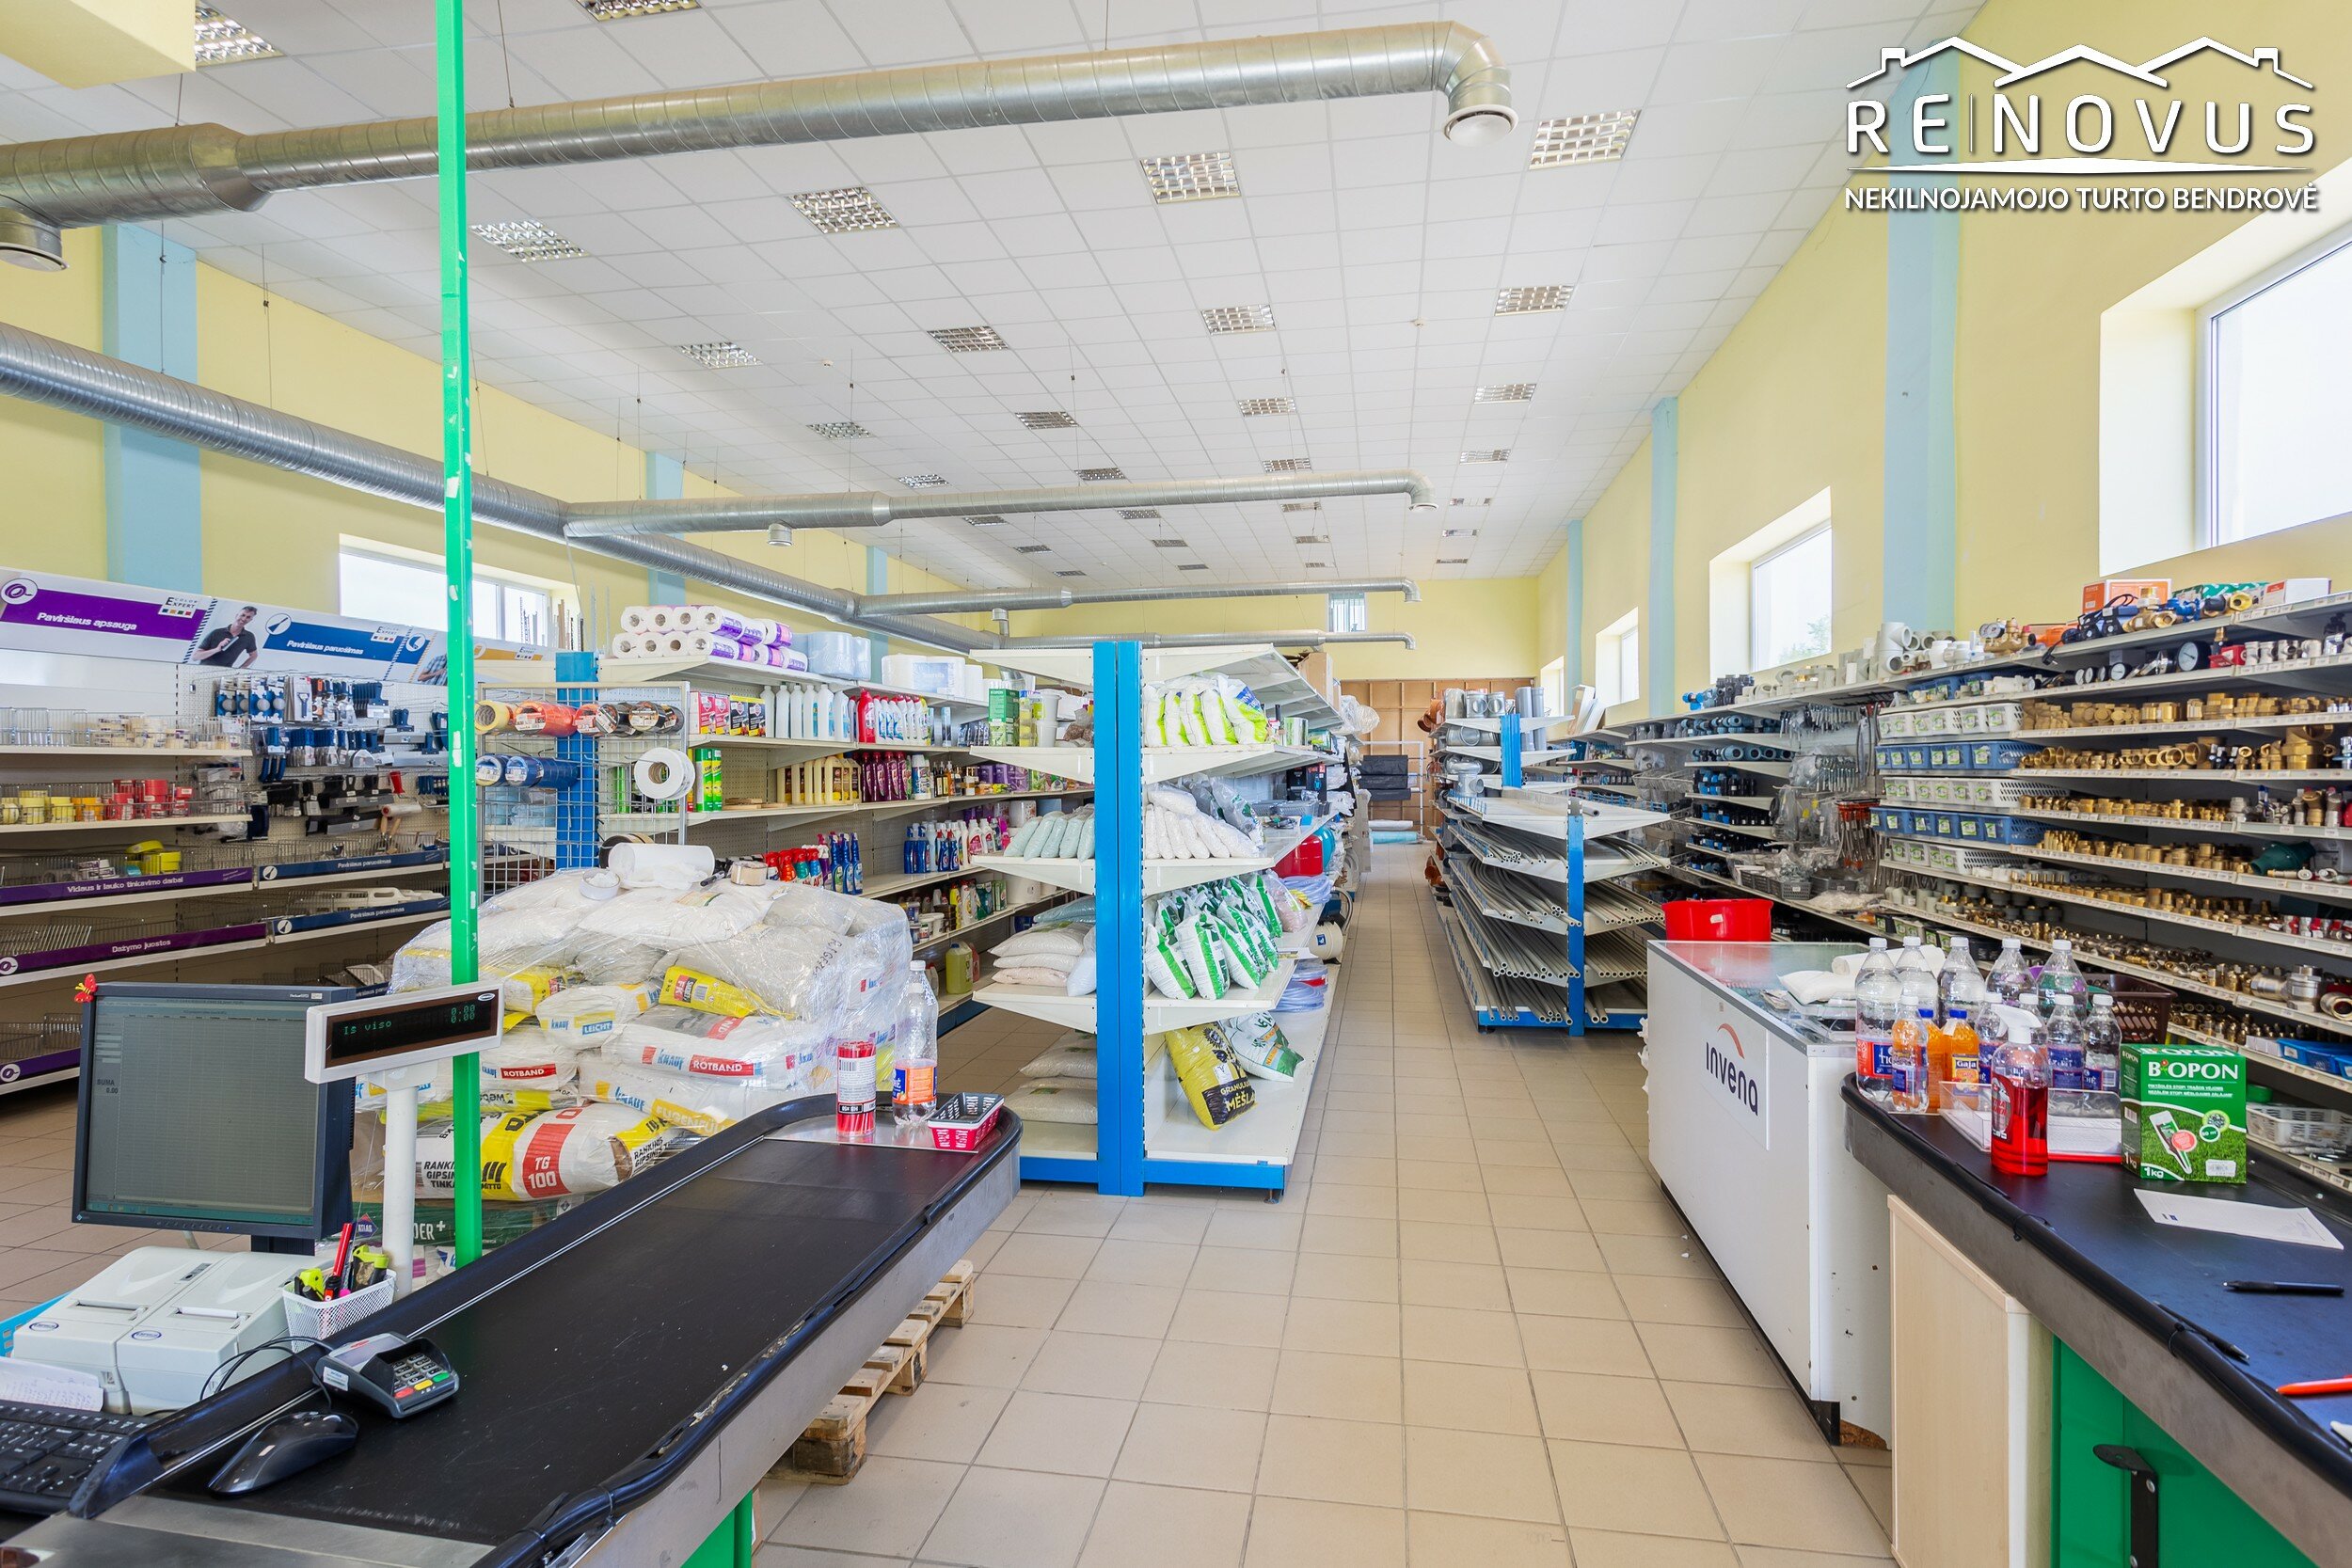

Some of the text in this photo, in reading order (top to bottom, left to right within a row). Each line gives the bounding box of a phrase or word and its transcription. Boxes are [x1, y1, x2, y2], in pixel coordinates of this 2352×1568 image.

[37, 611, 137, 631] Paviršiaus apsauga
[67, 884, 95, 894] Vidaus
[103, 881, 125, 891] lauko
[126, 878, 162, 889] tinkavimo
[162, 876, 184, 884] darbai
[143, 939, 171, 950] juostos
[364, 1020, 392, 1032] viso
[550, 1019, 570, 1031] KNAUF
[583, 1021, 612, 1034] LEICHT
[658, 1049, 743, 1073] KNAUF ROTBAND
[502, 1068, 545, 1079] ROTBAND
[96, 1078, 115, 1086] SUMA
[614, 1086, 645, 1112] KNAUF
[423, 1161, 454, 1170] RANKI
[534, 1155, 551, 1170] TG
[2144, 1166, 2164, 1180] 1kg
[528, 1170, 557, 1190] 100
[358, 1224, 373, 1233] ATLAS
